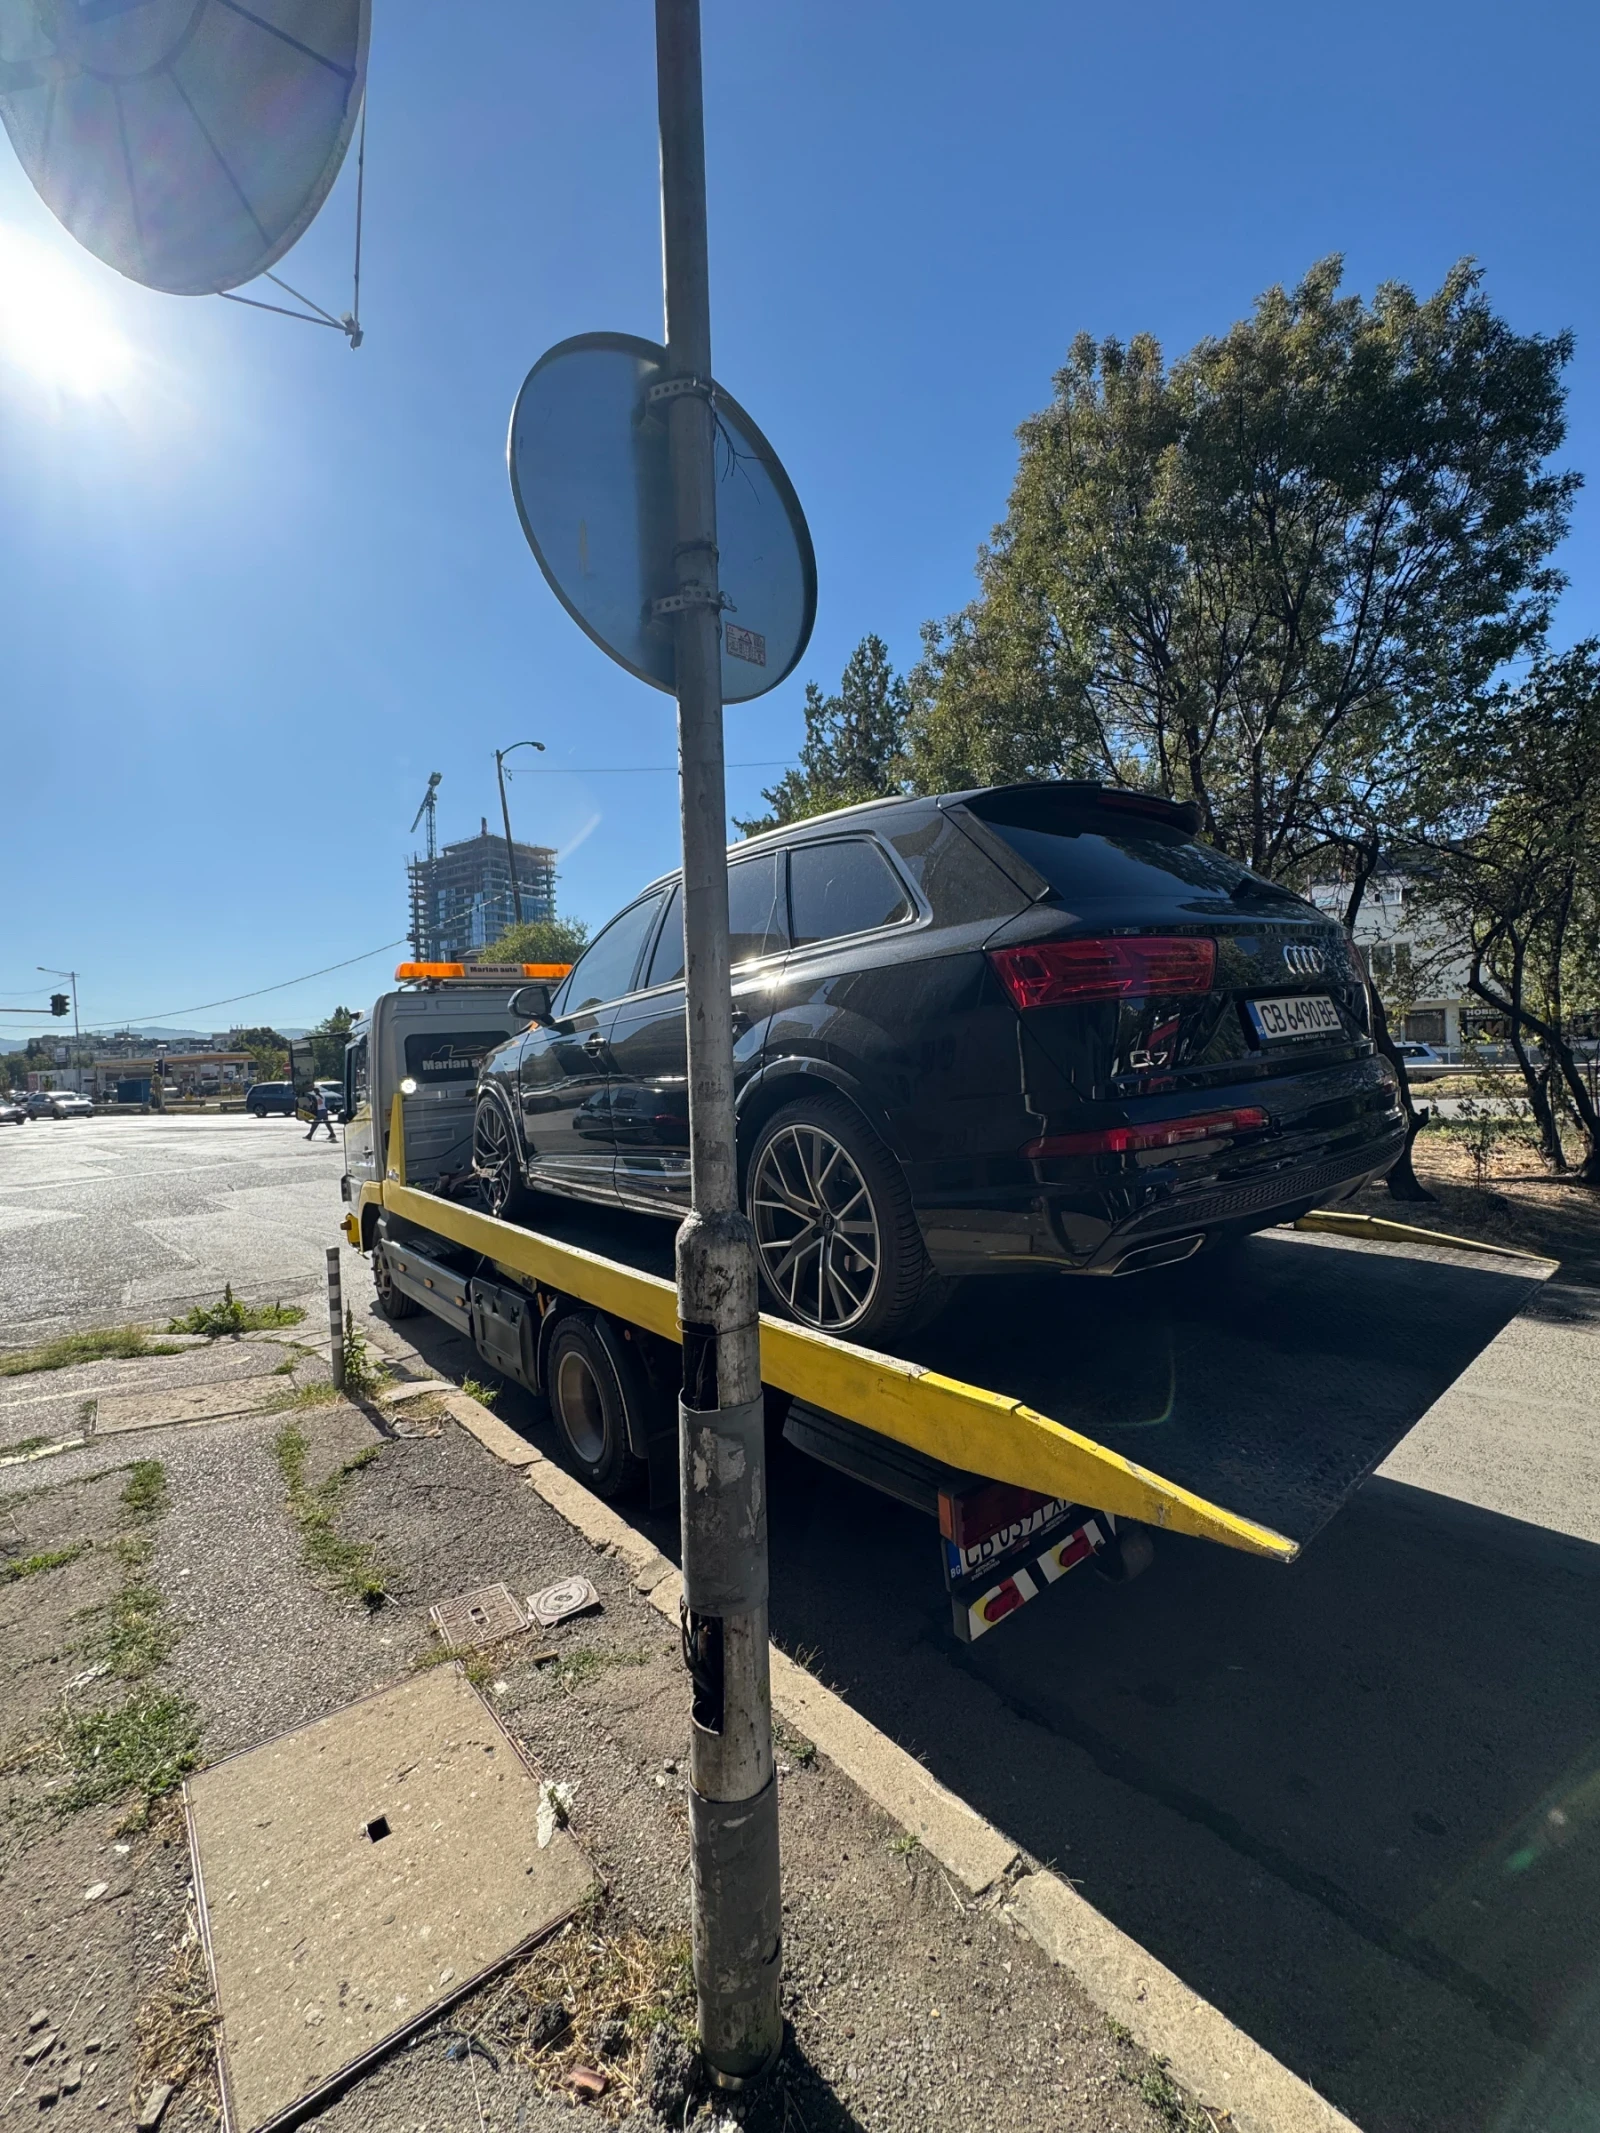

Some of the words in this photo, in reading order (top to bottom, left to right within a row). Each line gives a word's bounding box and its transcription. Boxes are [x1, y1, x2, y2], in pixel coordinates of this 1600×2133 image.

[422, 1059, 469, 1071] Marian
[1129, 1049, 1169, 1068] Q7
[950, 1565, 962, 1579] BG
